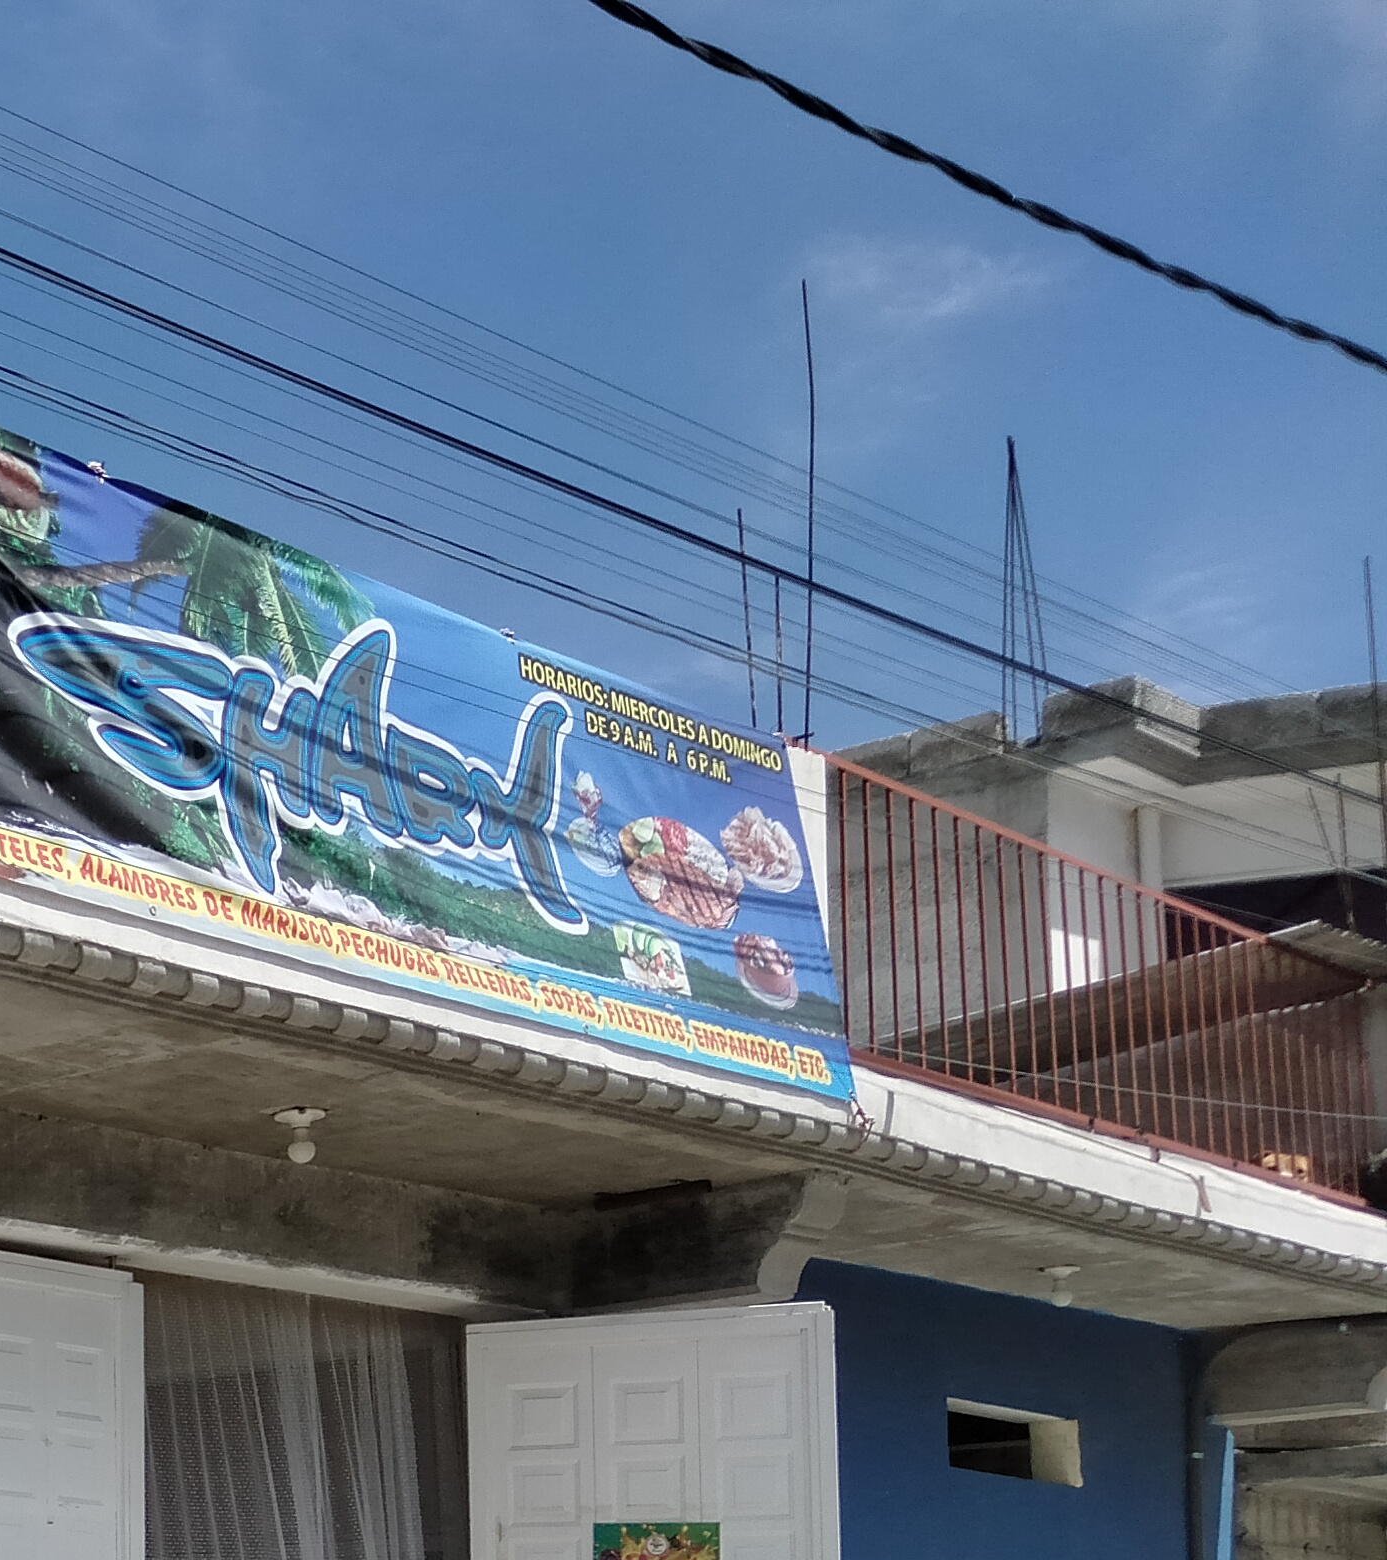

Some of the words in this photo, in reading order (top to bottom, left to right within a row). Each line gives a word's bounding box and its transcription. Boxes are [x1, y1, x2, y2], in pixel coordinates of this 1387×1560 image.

[7, 612, 589, 935] SHARK
[519, 655, 609, 708] HORARIOS:
[611, 690, 696, 741] MIERCOLES
[698, 724, 710, 746] A
[711, 727, 782, 772] DOMINGO
[586, 711, 607, 738] DE
[624, 727, 658, 757] A.M.
[666, 742, 678, 764] A
[687, 749, 697, 770] 6
[698, 753, 731, 784] P.M.
[79, 853, 197, 911] ALAMBRES
[202, 890, 233, 921] DE
[443, 960, 539, 1008] RELLENAS,
[543, 984, 603, 1024] SOPAS,
[606, 1001, 693, 1047] FILETITOS,
[694, 1026, 794, 1075] EMPANADAS,
[798, 1051, 829, 1079] ETC.
